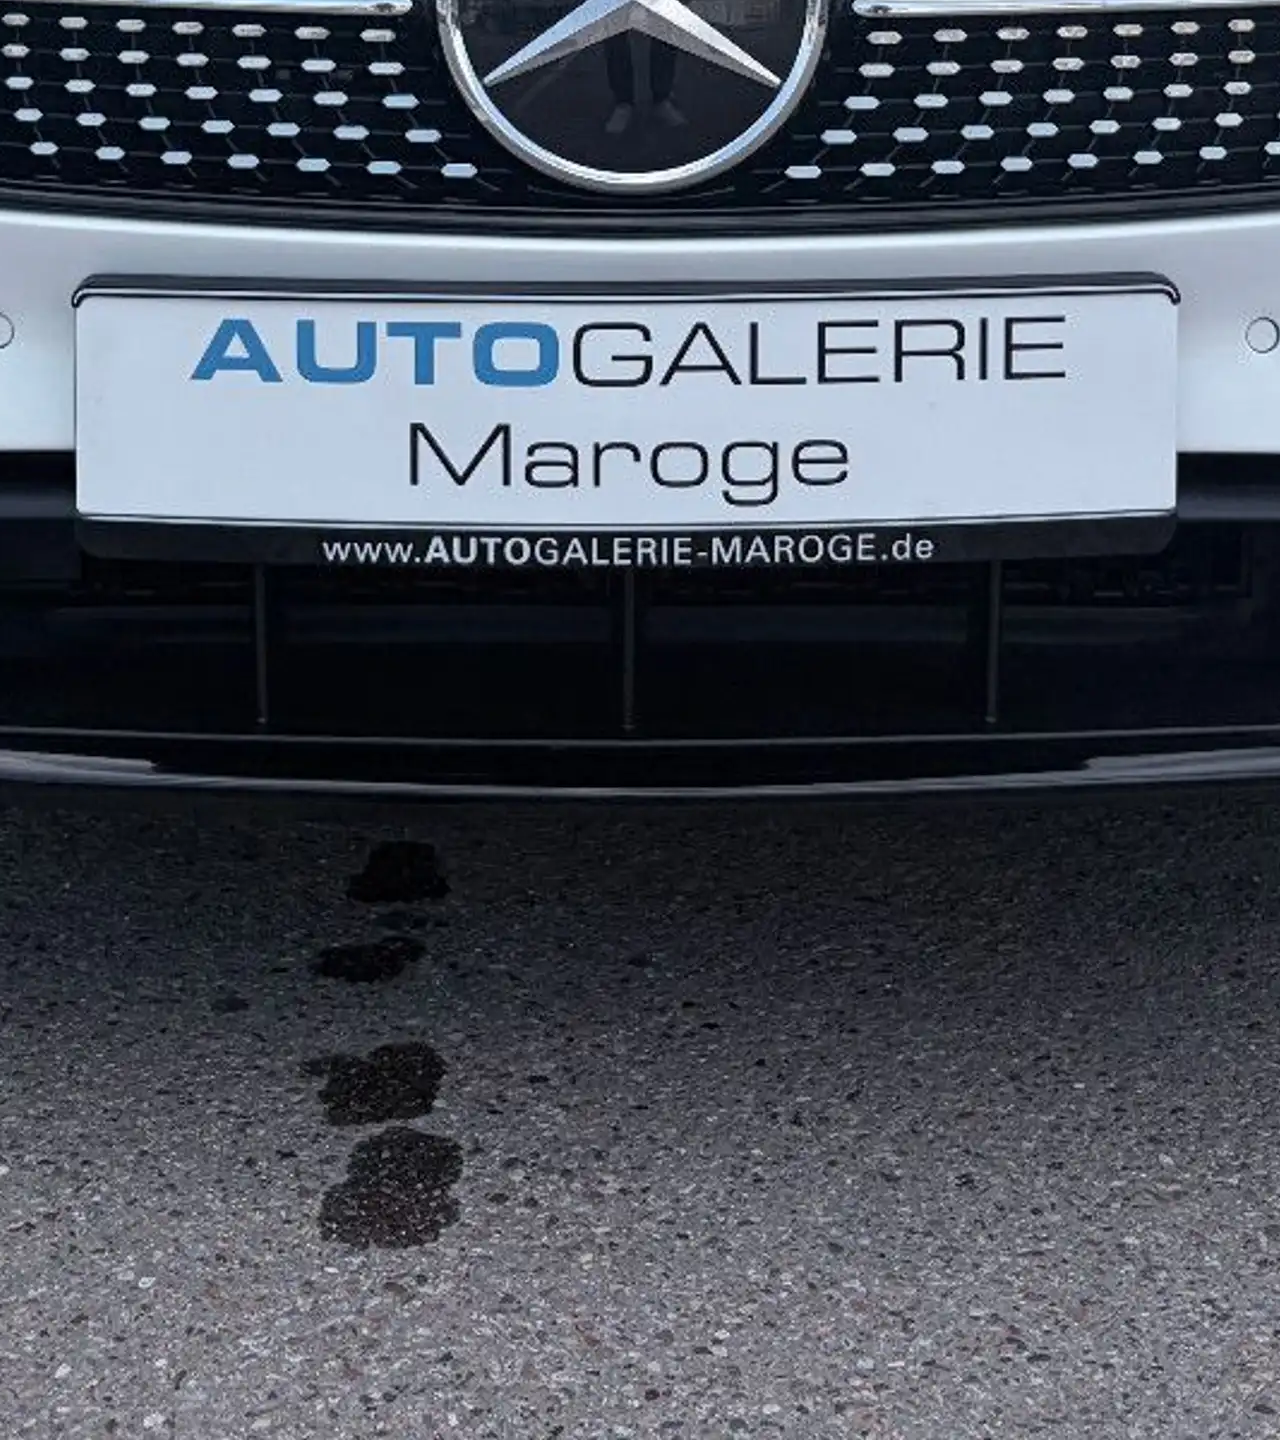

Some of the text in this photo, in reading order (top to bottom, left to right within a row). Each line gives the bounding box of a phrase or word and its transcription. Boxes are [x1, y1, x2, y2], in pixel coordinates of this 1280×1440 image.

[190, 315, 1067, 388] AUTOGALERIE
[409, 422, 849, 507] Maroge
[322, 532, 935, 567] www.AUTOGALERIE-MAROGE.de
